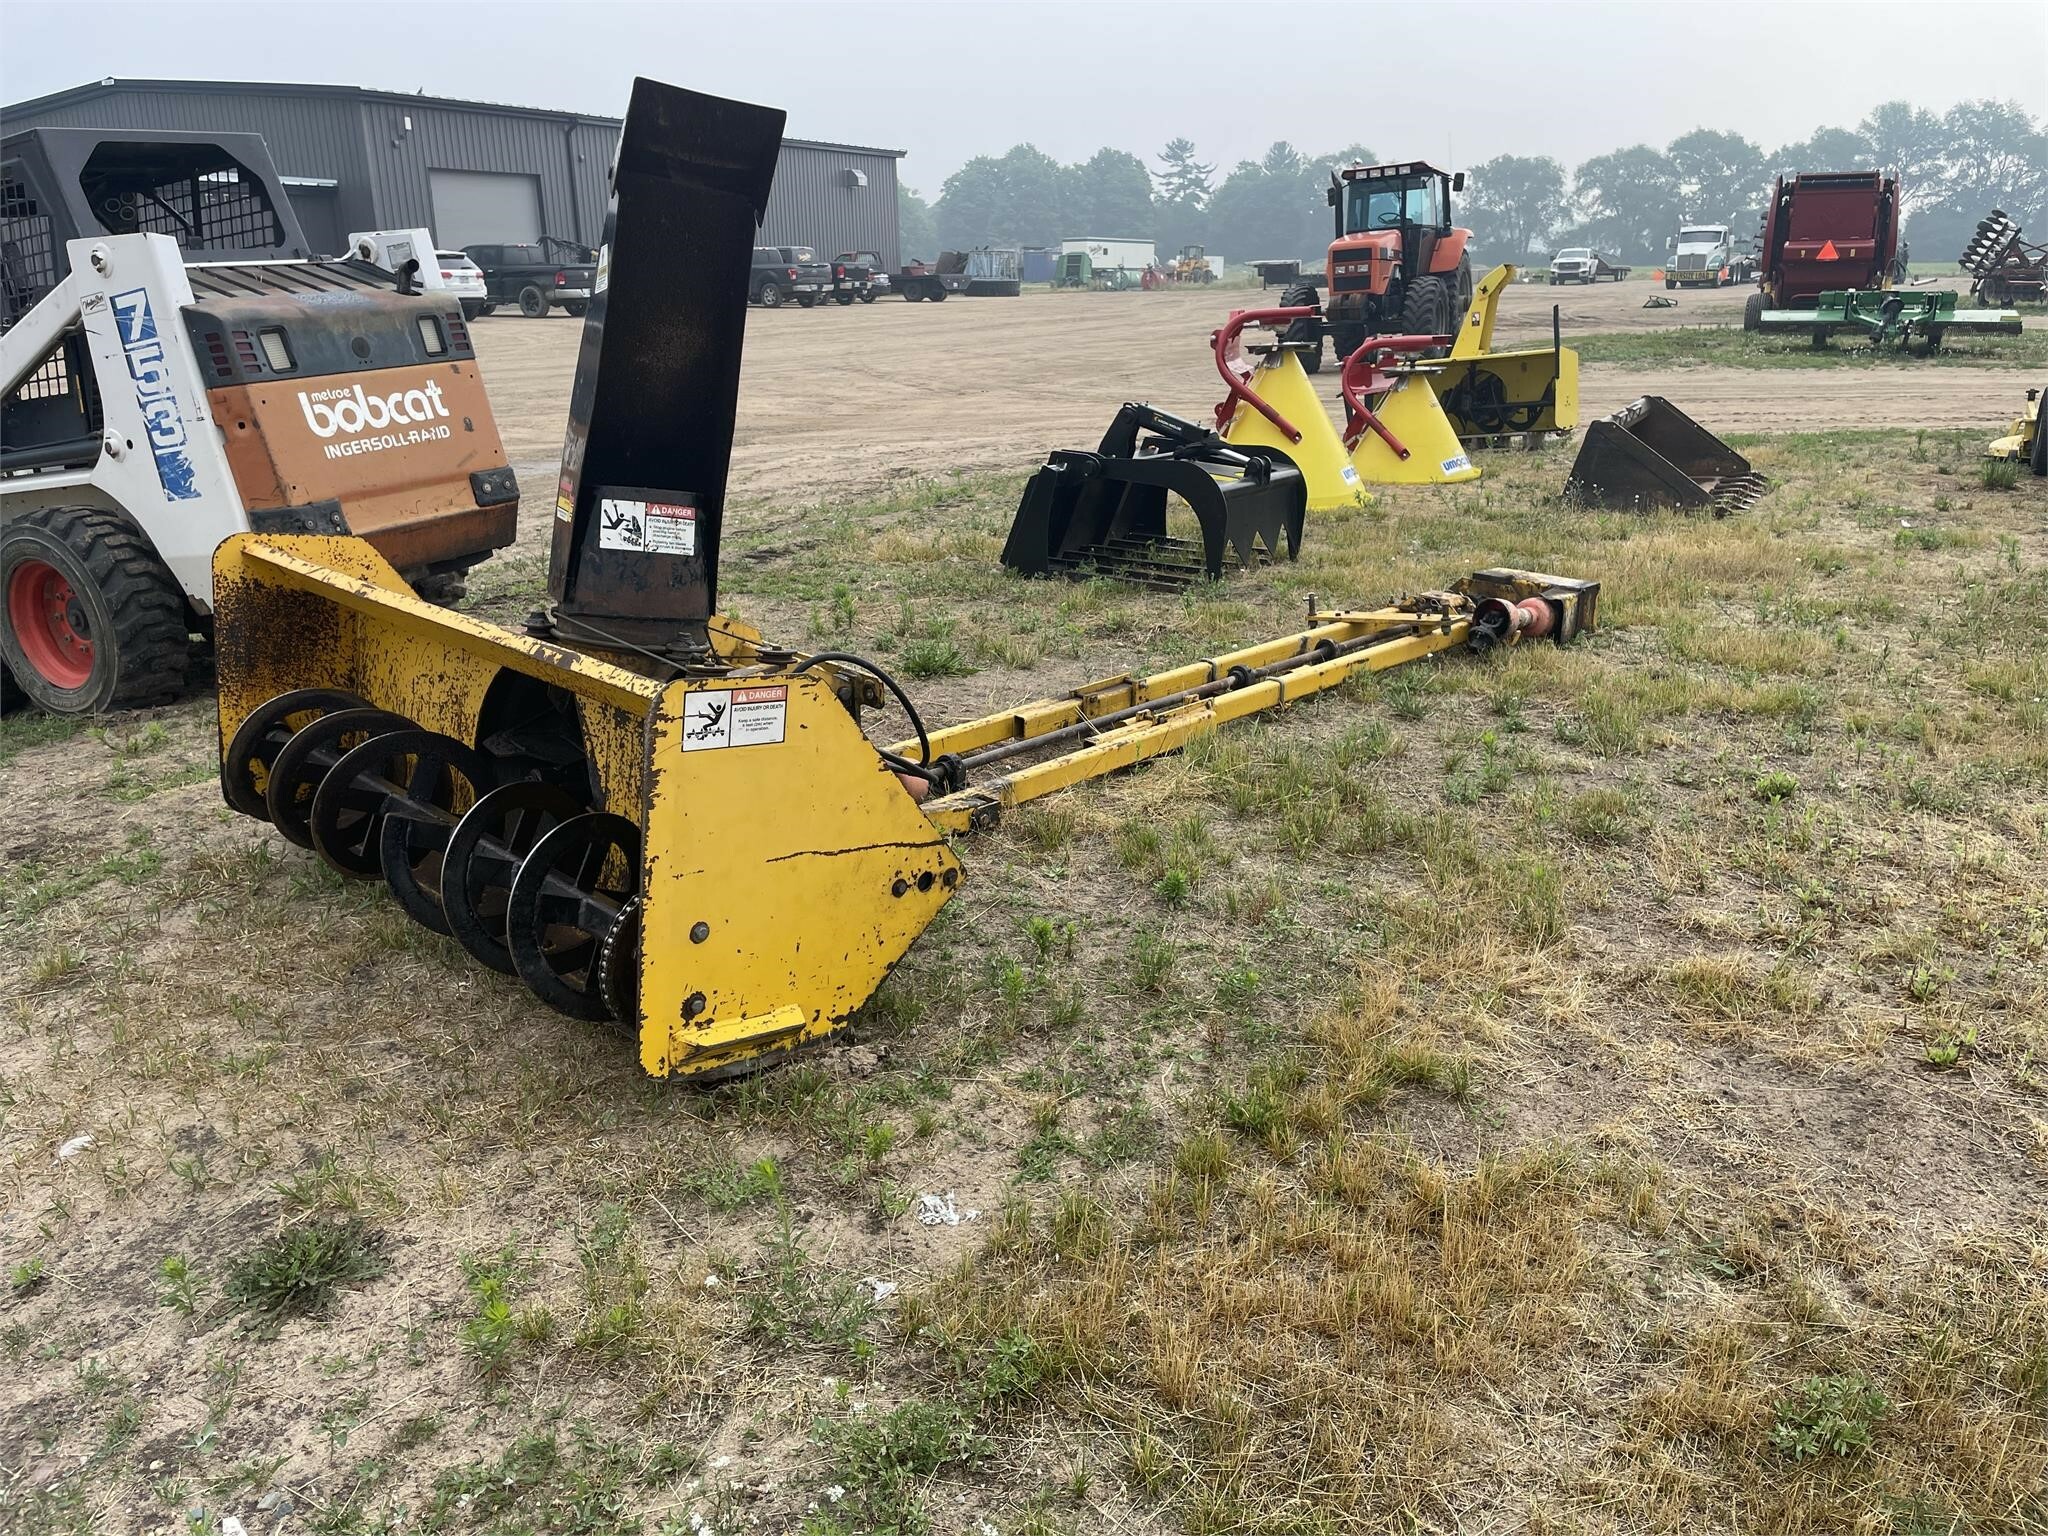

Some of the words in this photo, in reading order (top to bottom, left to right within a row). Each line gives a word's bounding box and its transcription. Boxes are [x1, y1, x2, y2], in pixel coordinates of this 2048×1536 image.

[311, 387, 352, 403] melroe
[298, 379, 450, 438] bobcat
[661, 506, 692, 516] DANGER
[749, 690, 783, 700] DANGER
